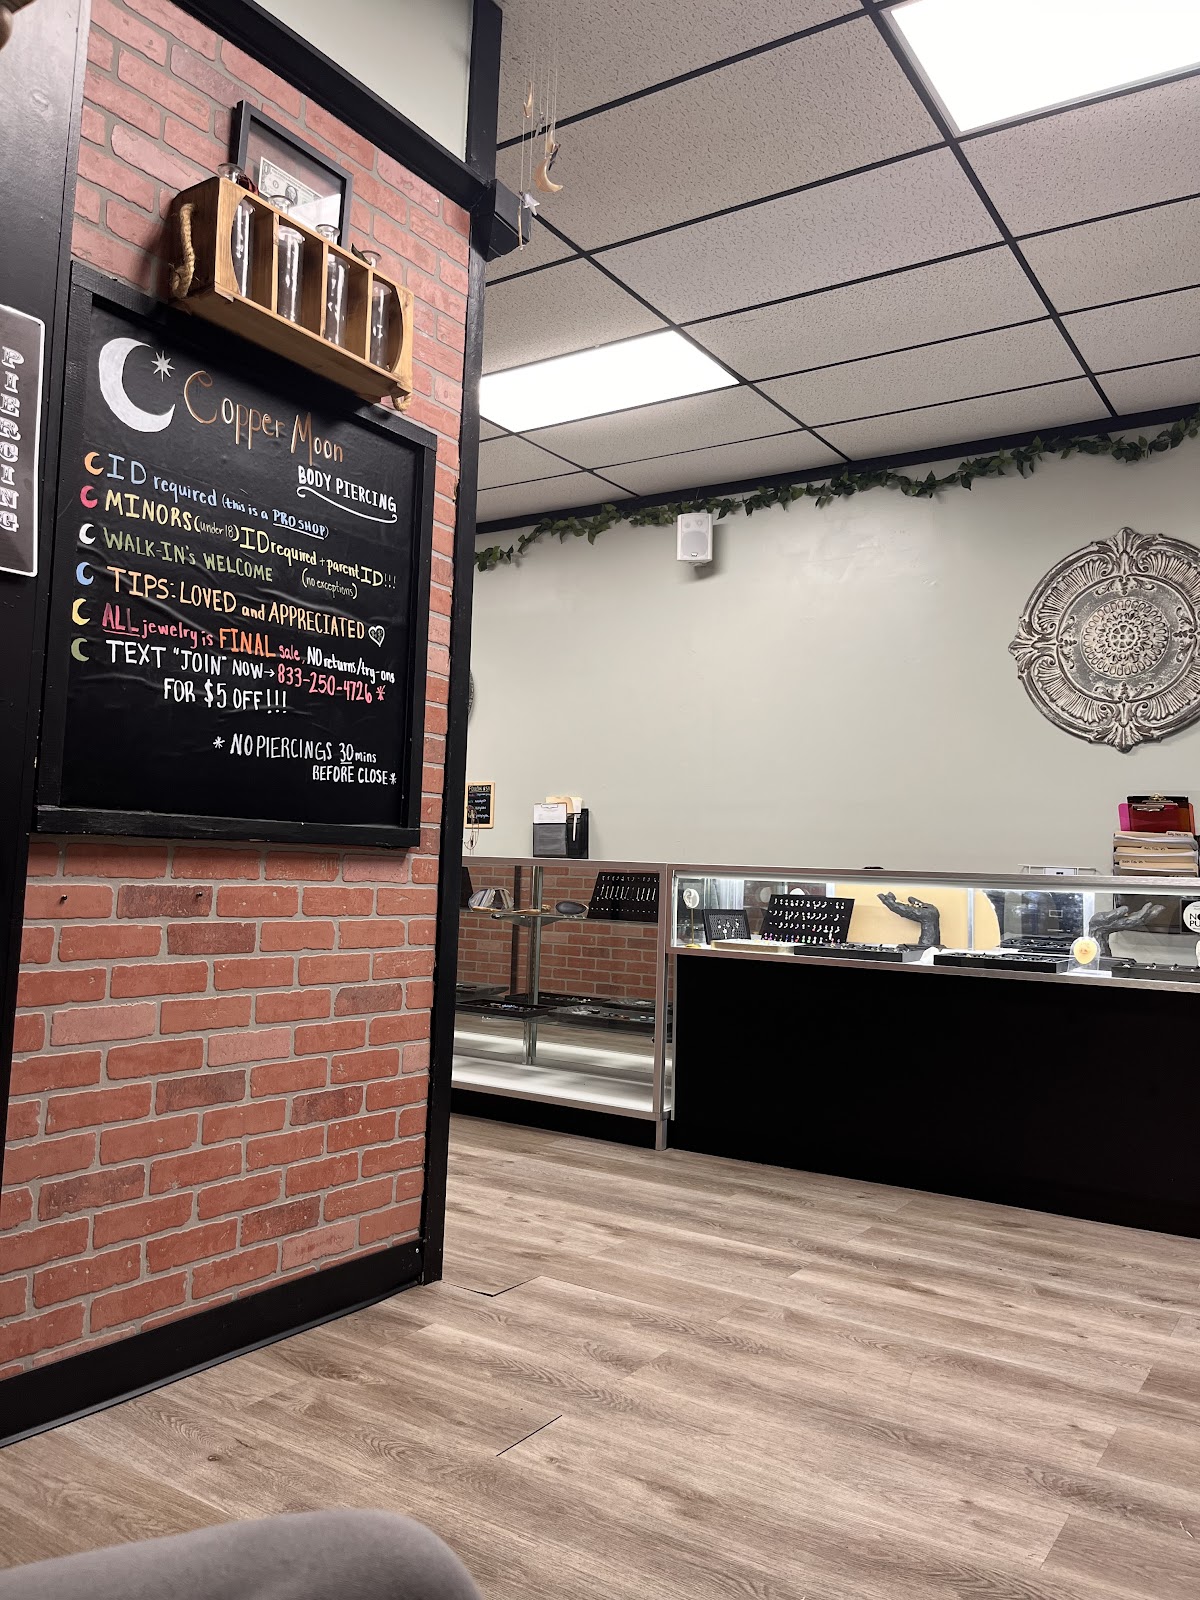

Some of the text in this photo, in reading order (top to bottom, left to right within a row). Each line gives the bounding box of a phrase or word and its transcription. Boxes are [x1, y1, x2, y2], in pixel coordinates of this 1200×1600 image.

[0, 345, 24, 532] PIERCING
[184, 370, 344, 466] Copper Moon
[106, 453, 330, 538] ID required (this is a PRO SHOP)
[298, 465, 397, 512] BODY PIERCING
[203, 552, 272, 582] WELCOME
[302, 568, 358, 600] (no exceptions)
[102, 602, 139, 632] ALL
[142, 620, 198, 650] jewelry
[202, 630, 214, 646] is
[220, 628, 276, 658] FINAL
[278, 644, 305, 664] sale,
[306, 646, 322, 666] NO
[180, 582, 236, 612] LOVED
[242, 604, 265, 620] and
[268, 602, 365, 639] APPRECIATED
[106, 640, 372, 704] TEXT "JOIN" NOW 833-250-4726
[164, 678, 196, 702] FOR
[204, 678, 227, 708] $5
[230, 733, 377, 764] NO PIERCINGS 30 mins
[312, 766, 354, 782] BEFORE
